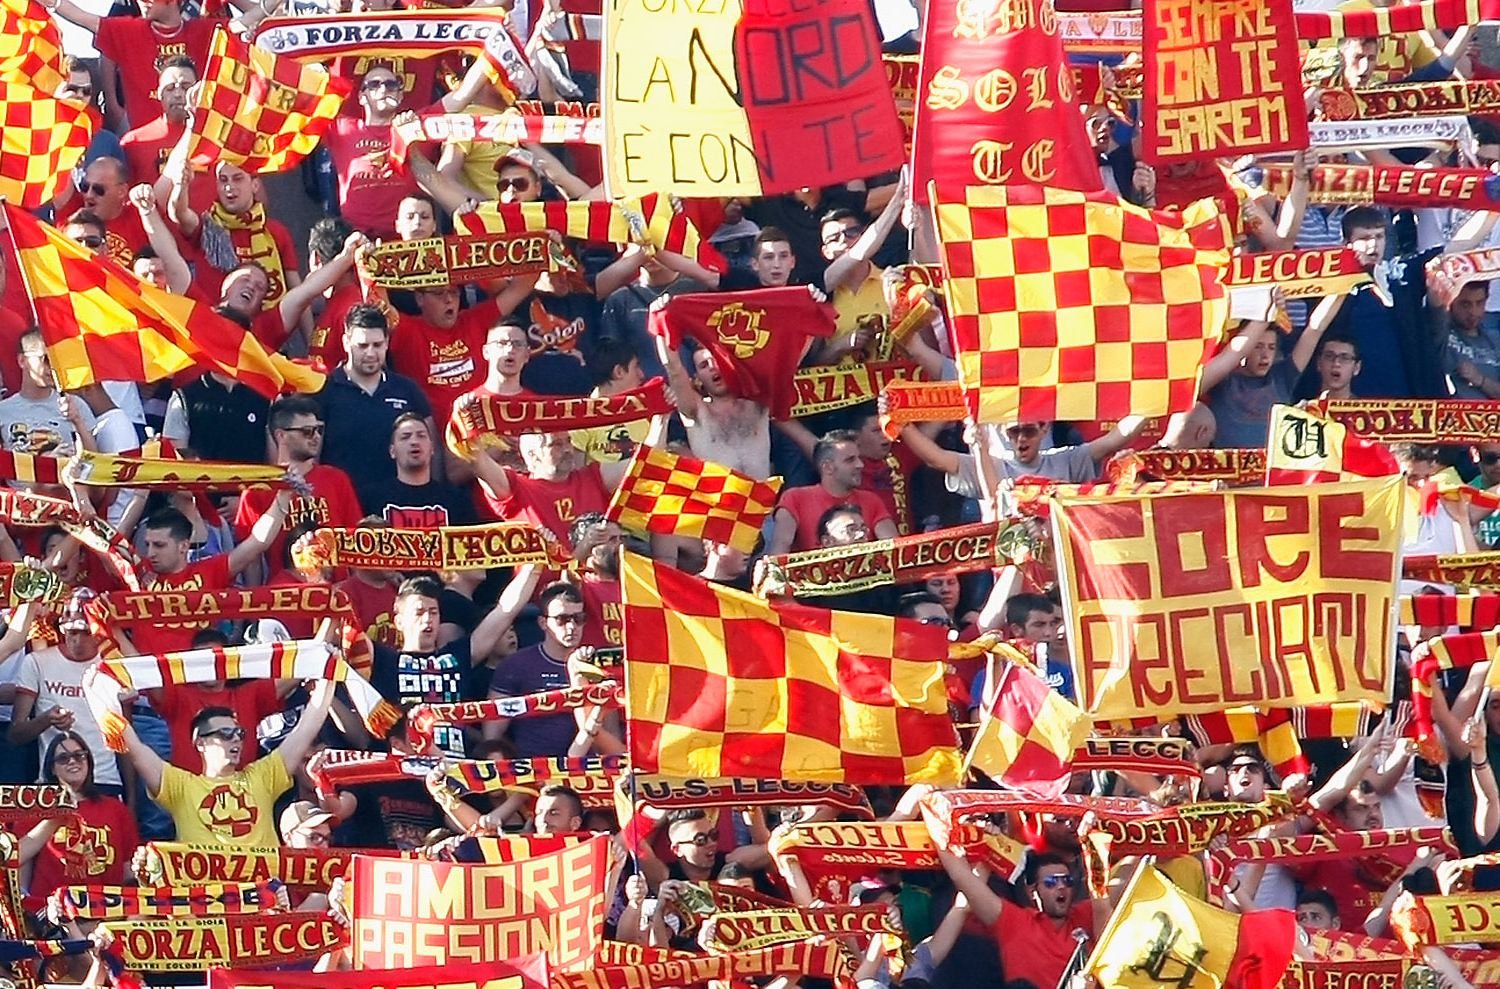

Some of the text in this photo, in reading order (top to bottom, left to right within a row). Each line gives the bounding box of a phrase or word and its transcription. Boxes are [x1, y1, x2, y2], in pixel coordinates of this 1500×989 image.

[308, 25, 403, 47] FORZA
[1156, 0, 1278, 49] SEMPRE
[615, 15, 876, 108] LA NORD
[1157, 41, 1283, 105] CON TE
[670, 132, 775, 185] CON
[804, 105, 886, 173] TE
[1377, 169, 1478, 199] LECCE
[450, 237, 545, 273] LECCE
[1232, 249, 1343, 284] LECCE
[790, 536, 993, 588] FORZA LECCE
[1063, 491, 1393, 602] CORE
[1080, 592, 1389, 709] PRECIATU
[171, 852, 274, 884] FORZA
[373, 842, 592, 920] AMORE
[112, 920, 340, 960] FORZA LECCE
